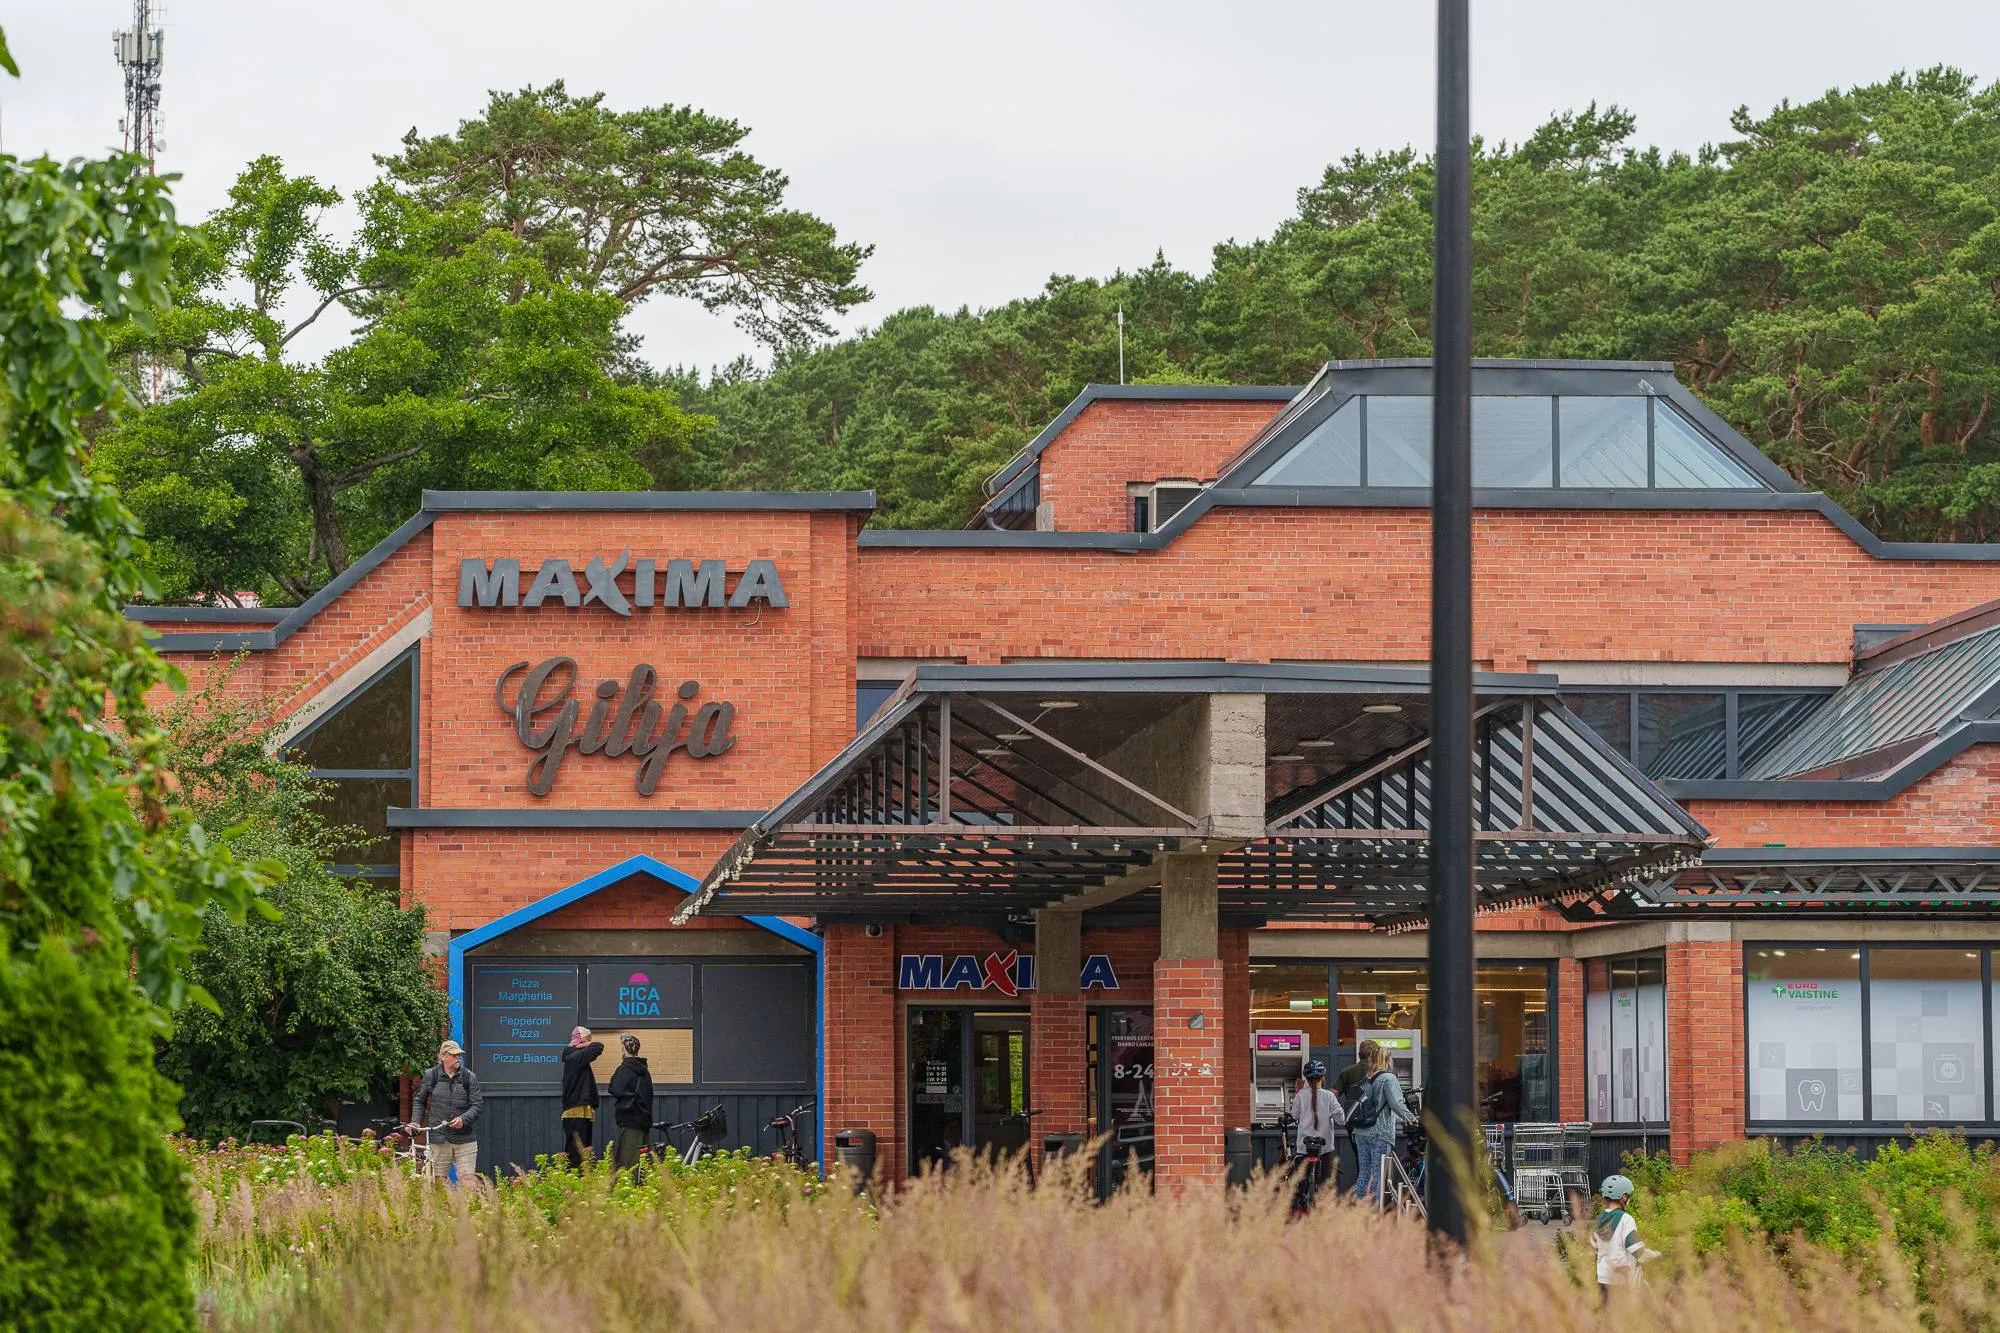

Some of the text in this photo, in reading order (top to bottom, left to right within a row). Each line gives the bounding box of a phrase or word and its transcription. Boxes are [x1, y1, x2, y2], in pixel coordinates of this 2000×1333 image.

[457, 547, 790, 617] MAXIMA
[898, 949, 1120, 997] MAXIA
[511, 978, 540, 988] Pizza
[499, 991, 553, 1003] Margherita
[618, 987, 660, 1001] PICA
[1788, 988, 1839, 999] VAISTINĖ
[618, 1001, 660, 1016] NIDA
[499, 1016, 552, 1027] Pepperoni
[511, 1028, 540, 1038] Pizza
[492, 1053, 558, 1063] Pizza Bianca
[1114, 1063, 1154, 1079] 8-24
